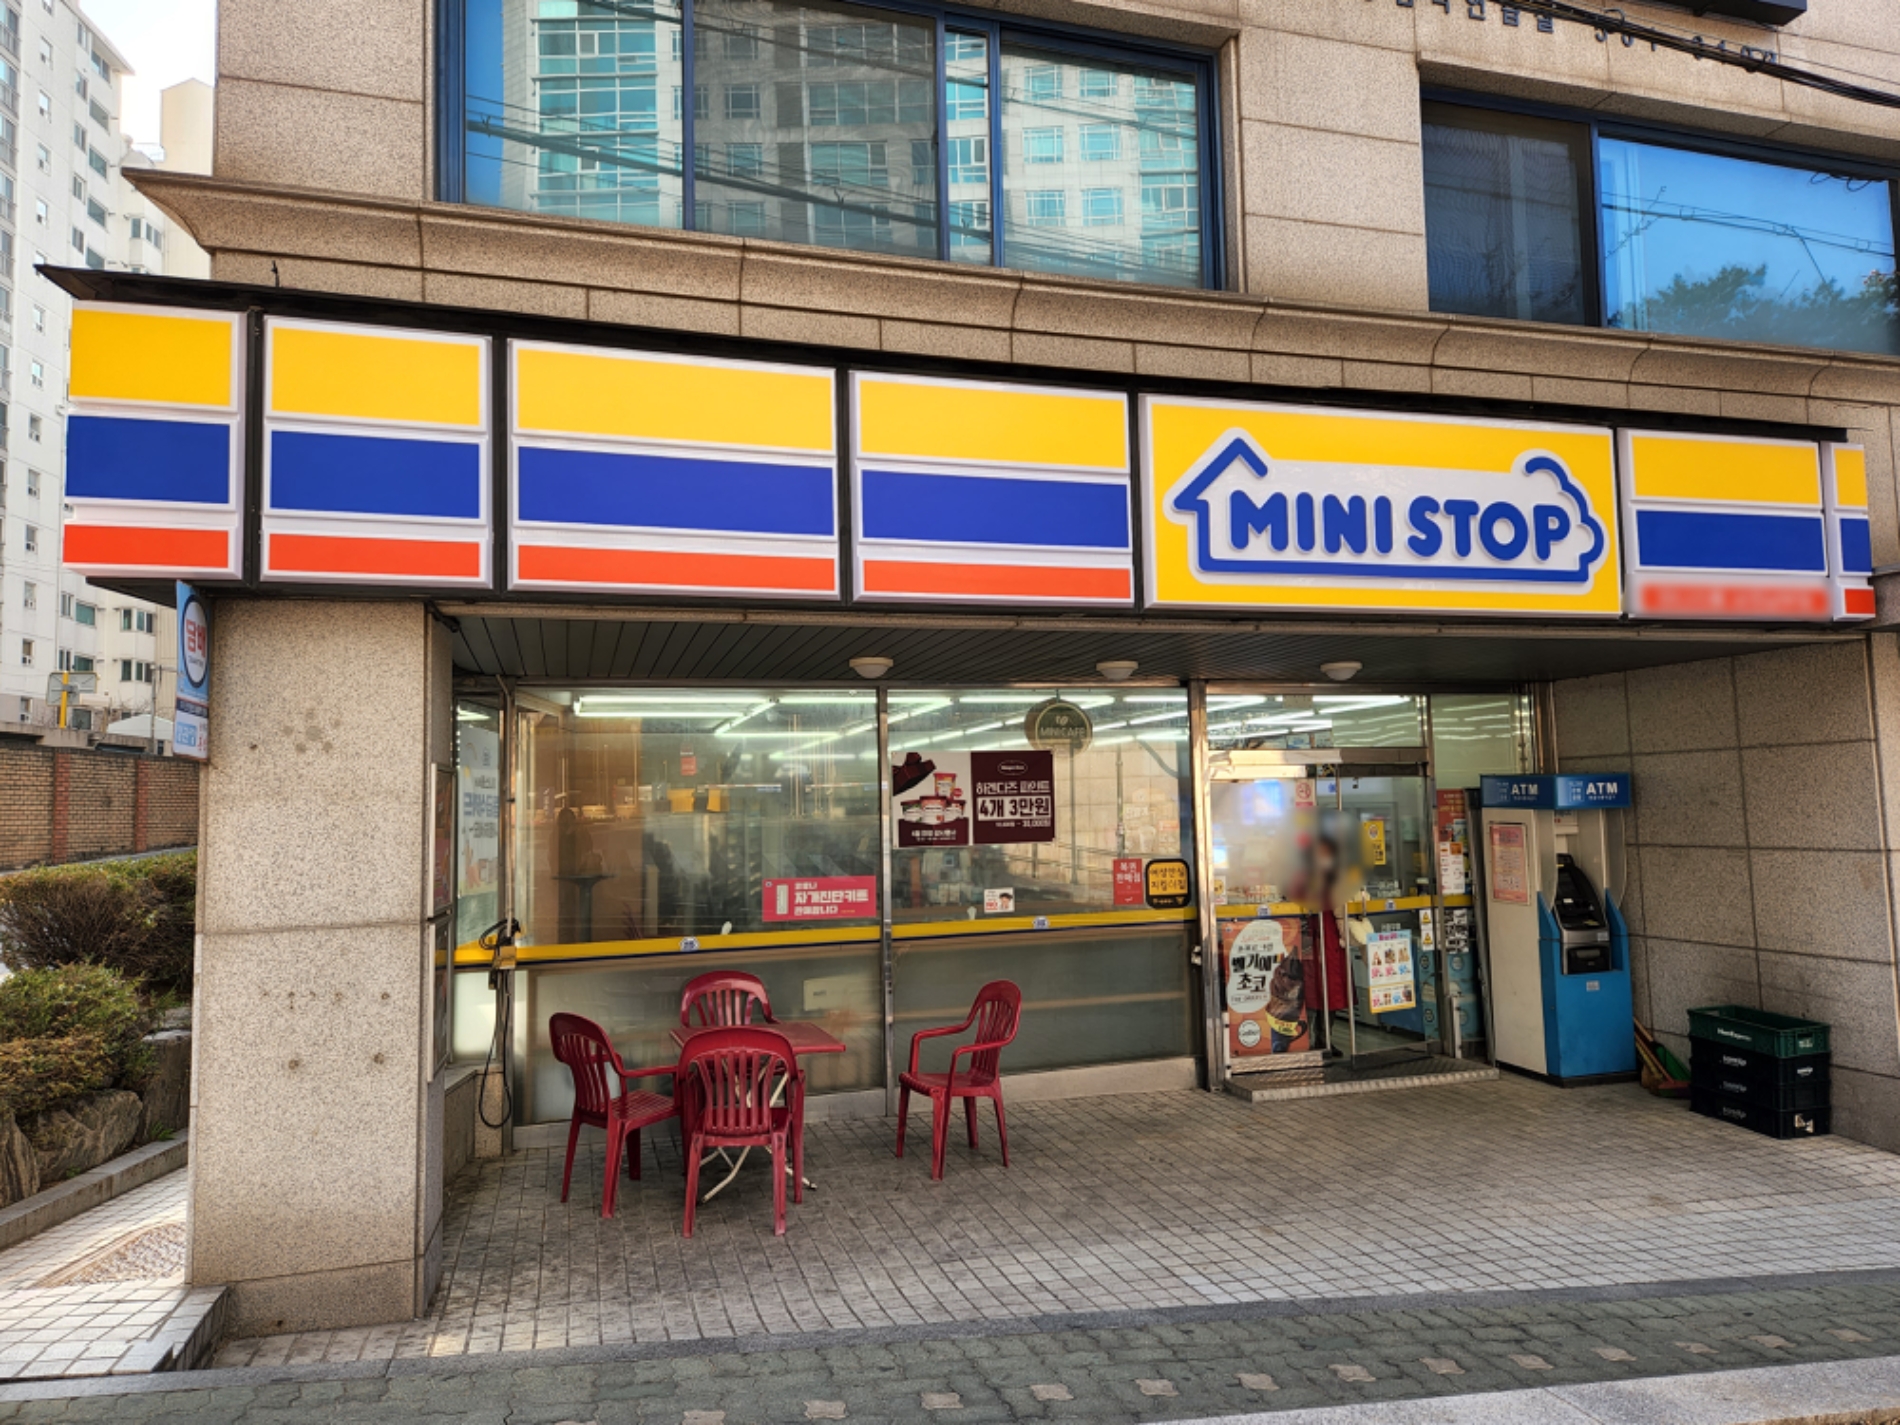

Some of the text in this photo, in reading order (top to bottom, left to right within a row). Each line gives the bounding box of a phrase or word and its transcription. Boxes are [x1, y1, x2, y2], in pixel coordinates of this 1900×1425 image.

[1511, 784, 1539, 795] ATM
[1586, 782, 1618, 795] ATM
[980, 797, 1050, 817] 4개 3만원
[794, 889, 869, 904] 자가진단키트
[1232, 953, 1271, 973] 벨기에
[1237, 973, 1266, 992] 초코
